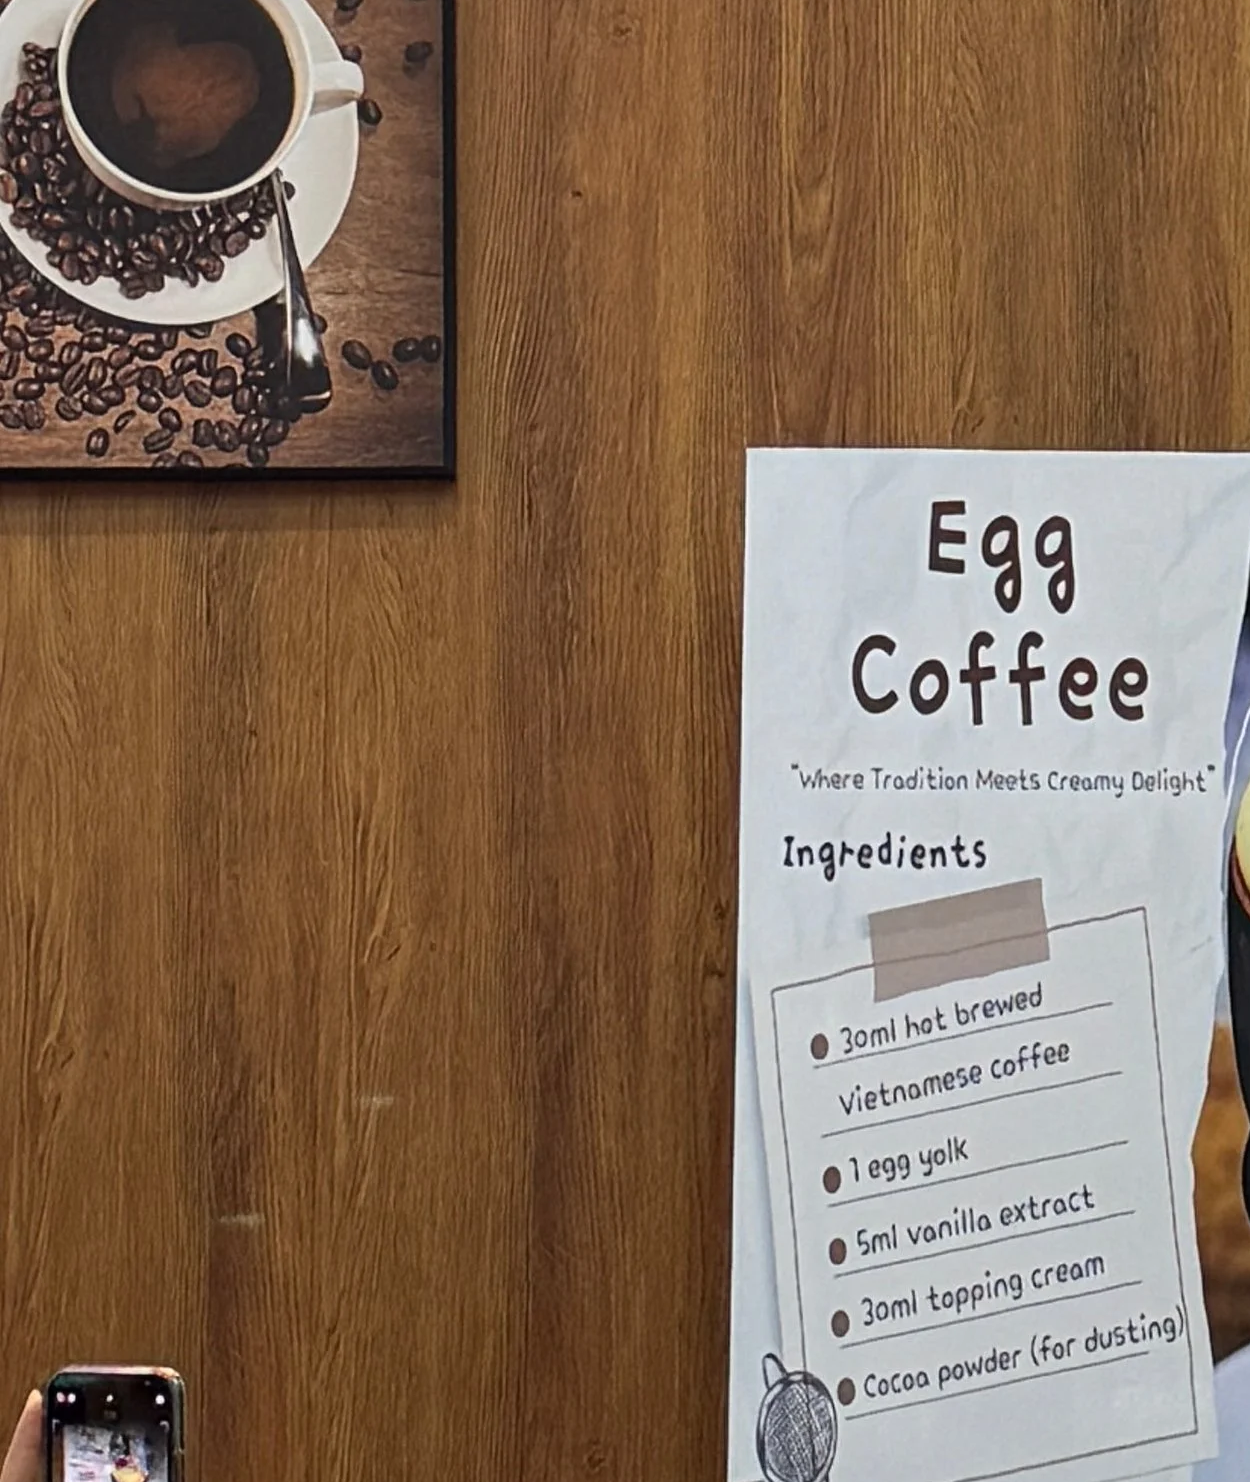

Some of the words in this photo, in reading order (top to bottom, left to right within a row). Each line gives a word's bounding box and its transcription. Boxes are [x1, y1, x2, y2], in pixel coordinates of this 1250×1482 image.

[928, 499, 1076, 614] Egg
[851, 630, 1149, 726] Coffee
[870, 766, 969, 791] Tradition
[975, 767, 1042, 791] Meets
[1047, 769, 1125, 798] Creamy
[783, 832, 988, 882] Ingredients
[839, 1018, 897, 1054] 30ml
[904, 1006, 948, 1039] hot
[954, 981, 1043, 1026] brewed
[989, 1041, 1071, 1079] coffee
[848, 1157, 860, 1182] 1
[868, 1153, 910, 1182] egg
[918, 1136, 969, 1177] yolk
[856, 1223, 898, 1256] 5ml
[906, 1206, 993, 1246] vanilla
[999, 1184, 1096, 1226] extract
[861, 1288, 918, 1326] 30ml
[926, 1270, 1024, 1315] topping
[1030, 1254, 1106, 1289] cream
[863, 1370, 931, 1399] Cocoa
[938, 1347, 1022, 1391] powder
[1030, 1334, 1076, 1367] (for
[1083, 1305, 1186, 1353] dusting)
